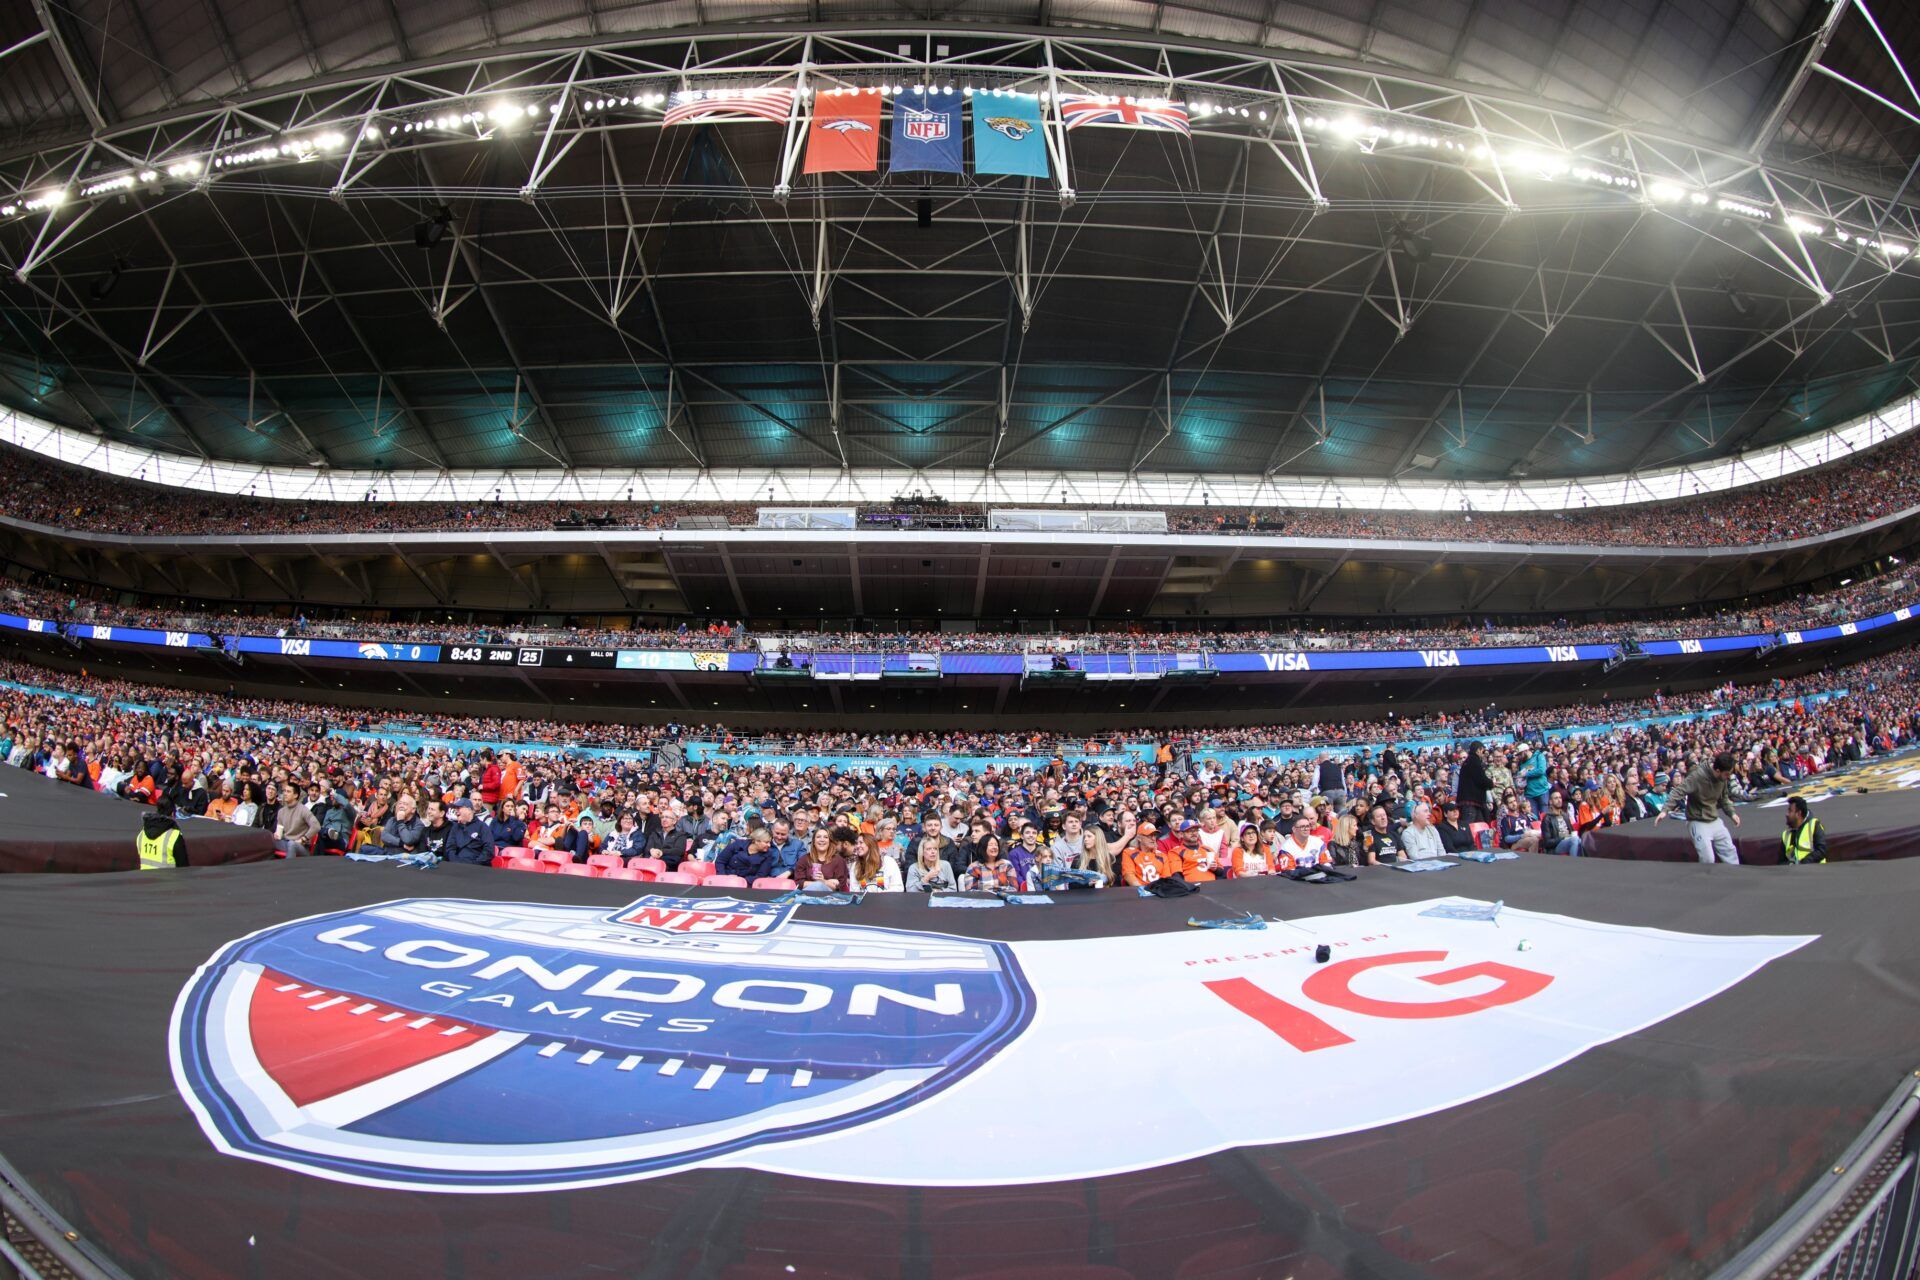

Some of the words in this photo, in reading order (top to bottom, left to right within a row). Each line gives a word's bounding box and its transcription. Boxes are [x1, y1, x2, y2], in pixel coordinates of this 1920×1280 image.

[909, 122, 944, 138] NFL
[92, 625, 112, 640] VISA
[165, 631, 189, 648] VISA
[1783, 631, 1803, 644] VISA
[279, 638, 310, 656] VISA
[411, 646, 421, 659] 0
[450, 647, 482, 661] 8:43
[1544, 646, 1579, 662] VISA
[1677, 639, 1703, 654] VISA
[489, 650, 513, 661] 2ND
[523, 652, 538, 663] 25
[566, 654, 573, 662] &
[638, 653, 660, 667] 10
[1259, 653, 1310, 671] VISA
[1418, 650, 1460, 667] VISA
[671, 726, 679, 734] 12
[144, 843, 158, 855] 171
[622, 907, 760, 932] NFL
[599, 933, 721, 949] 2022
[1183, 942, 1350, 967] PRESENTD
[1361, 933, 1391, 942] BY
[316, 923, 966, 1017] LONDON
[420, 980, 716, 1033] GAMES
[1200, 949, 1556, 1053] IG
